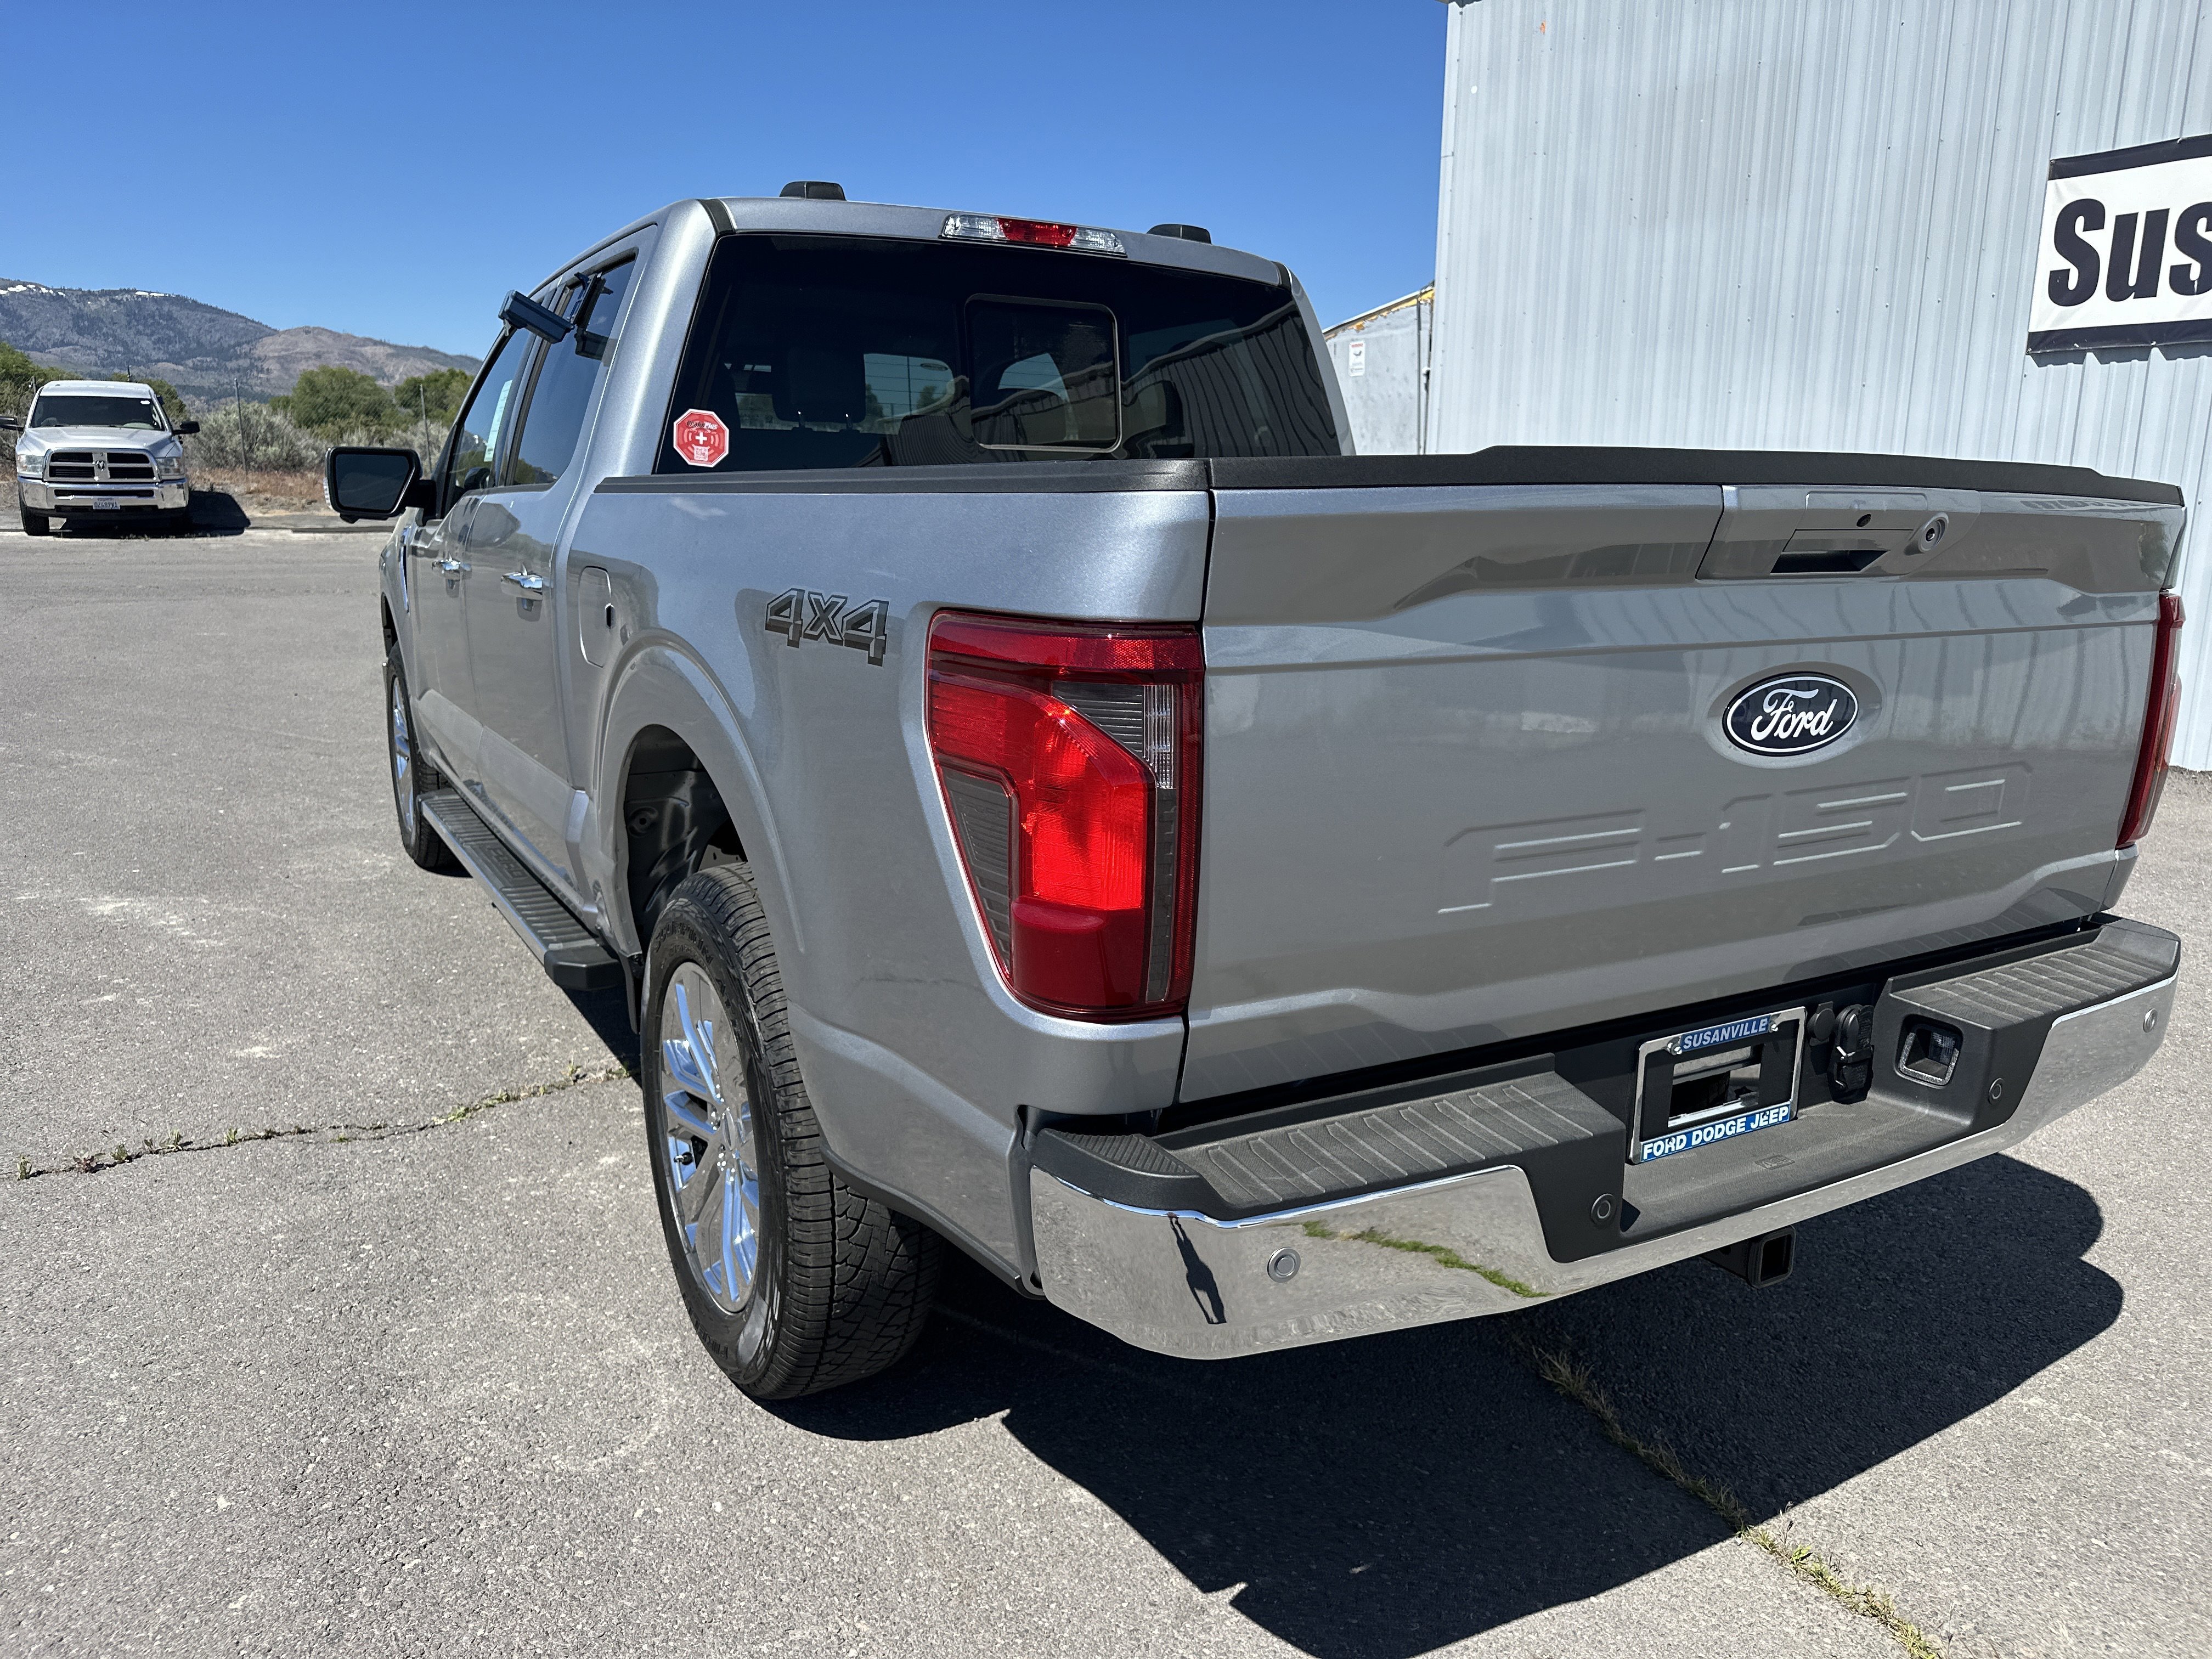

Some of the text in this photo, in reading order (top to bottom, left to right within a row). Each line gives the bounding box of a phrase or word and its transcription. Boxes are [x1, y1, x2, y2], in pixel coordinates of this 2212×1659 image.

[2048, 198, 2212, 307] Sus
[1751, 689, 1838, 741] Ford
[1437, 761, 2033, 915] F-150
[1683, 1018, 1768, 1049] SUSANVILLE
[1643, 1106, 1789, 1160] FORD DODGE JEEP
